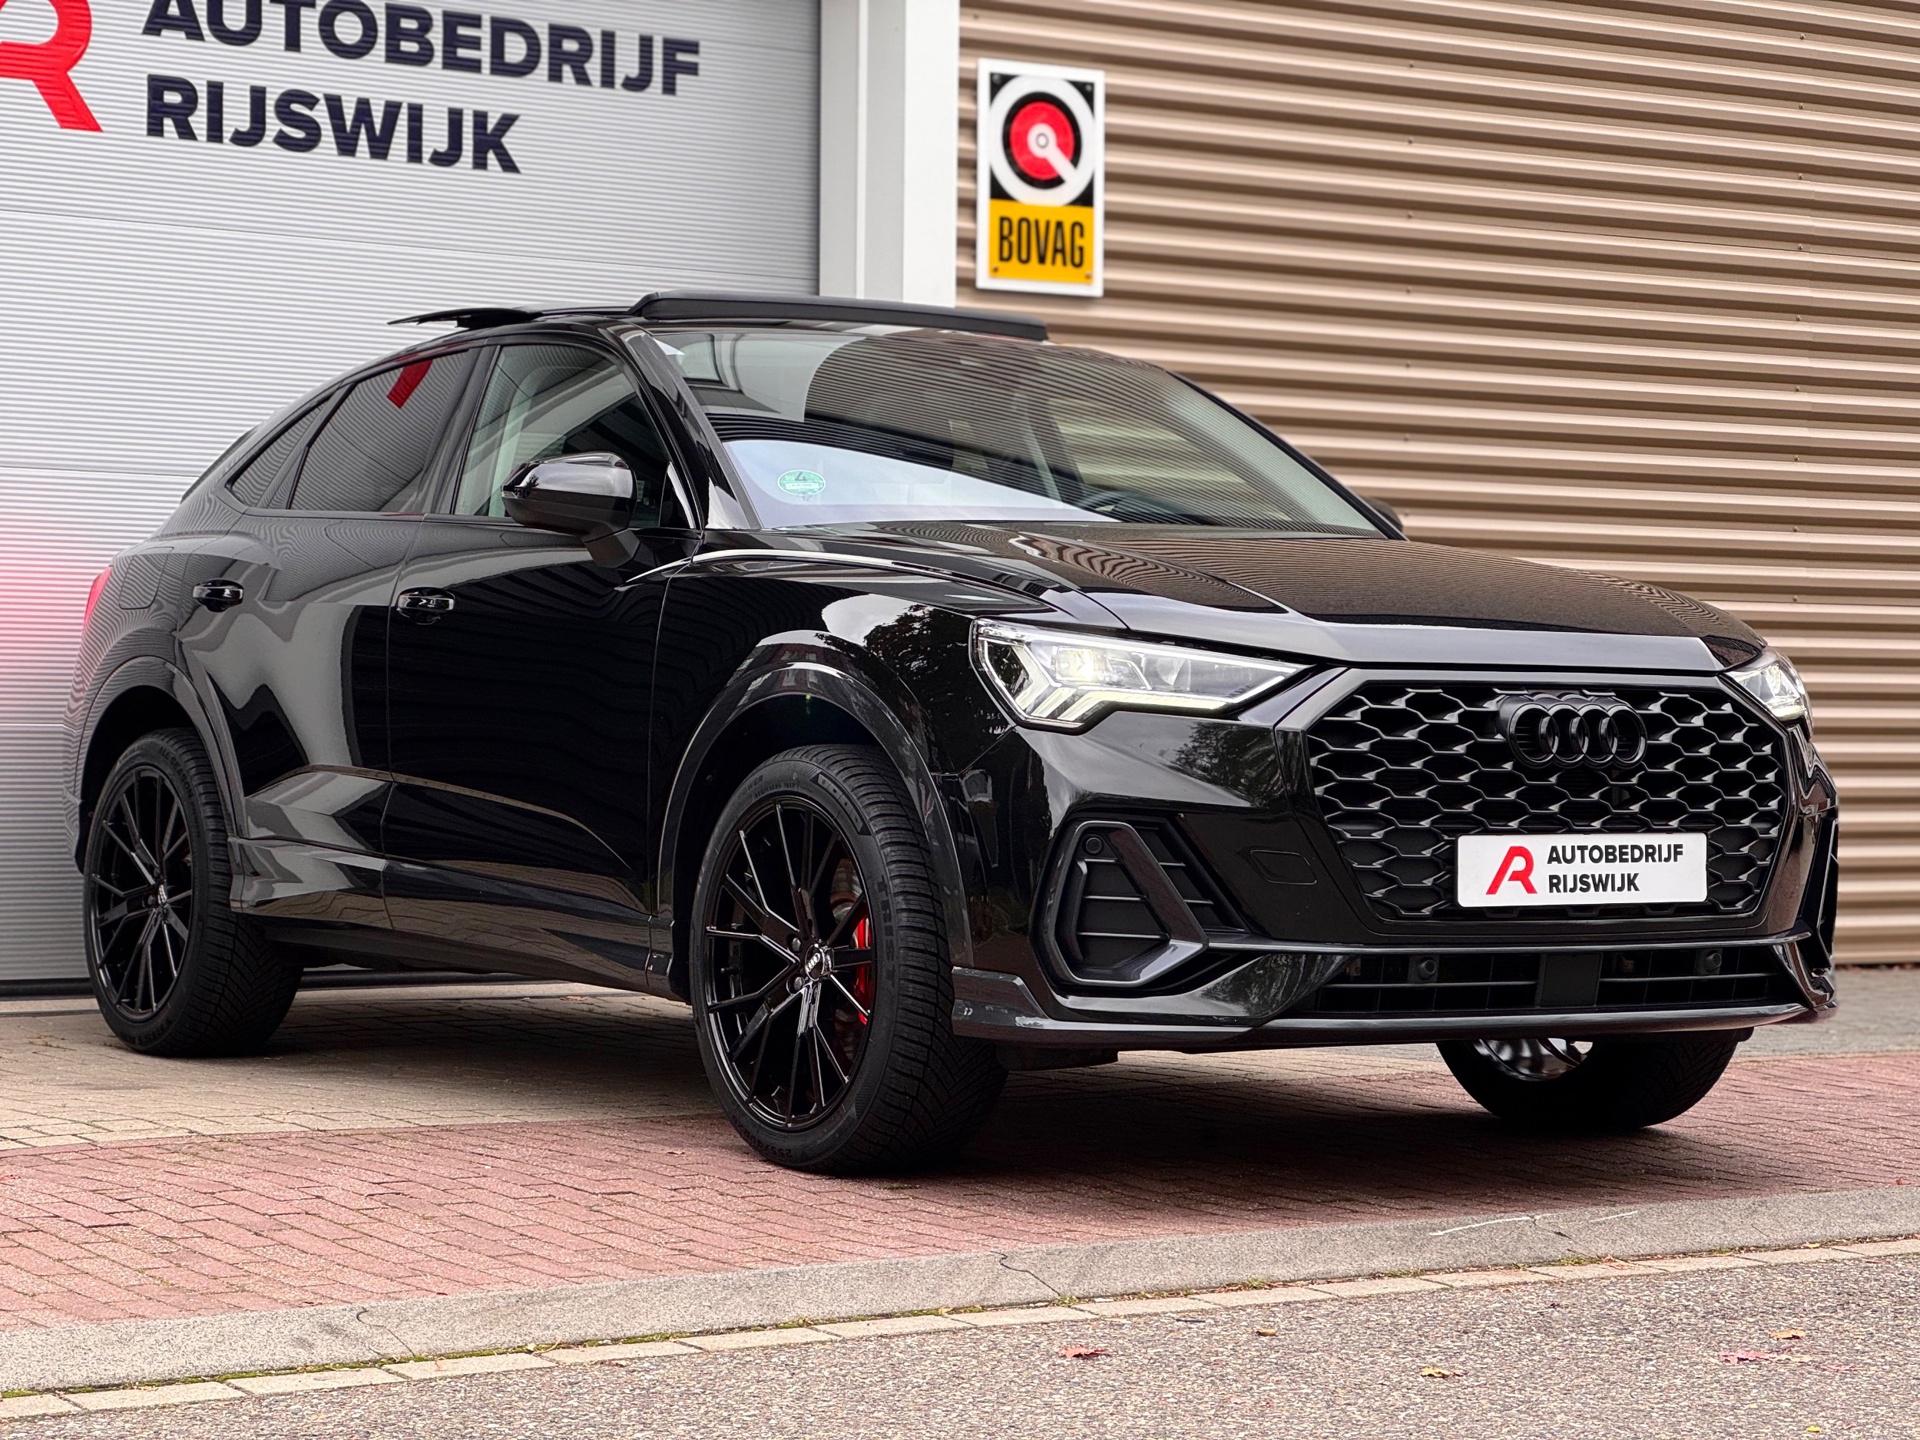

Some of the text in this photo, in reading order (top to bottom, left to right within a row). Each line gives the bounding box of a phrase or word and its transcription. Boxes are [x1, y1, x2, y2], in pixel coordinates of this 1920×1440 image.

[142, 0, 700, 96] AUTOBEDRIJF
[146, 73, 521, 174] RIJSWIJK
[998, 216, 1085, 268] BOVAG
[1547, 844, 1684, 865] AUTOBEDRIJF
[1548, 872, 1640, 894] RIJSWIJK
